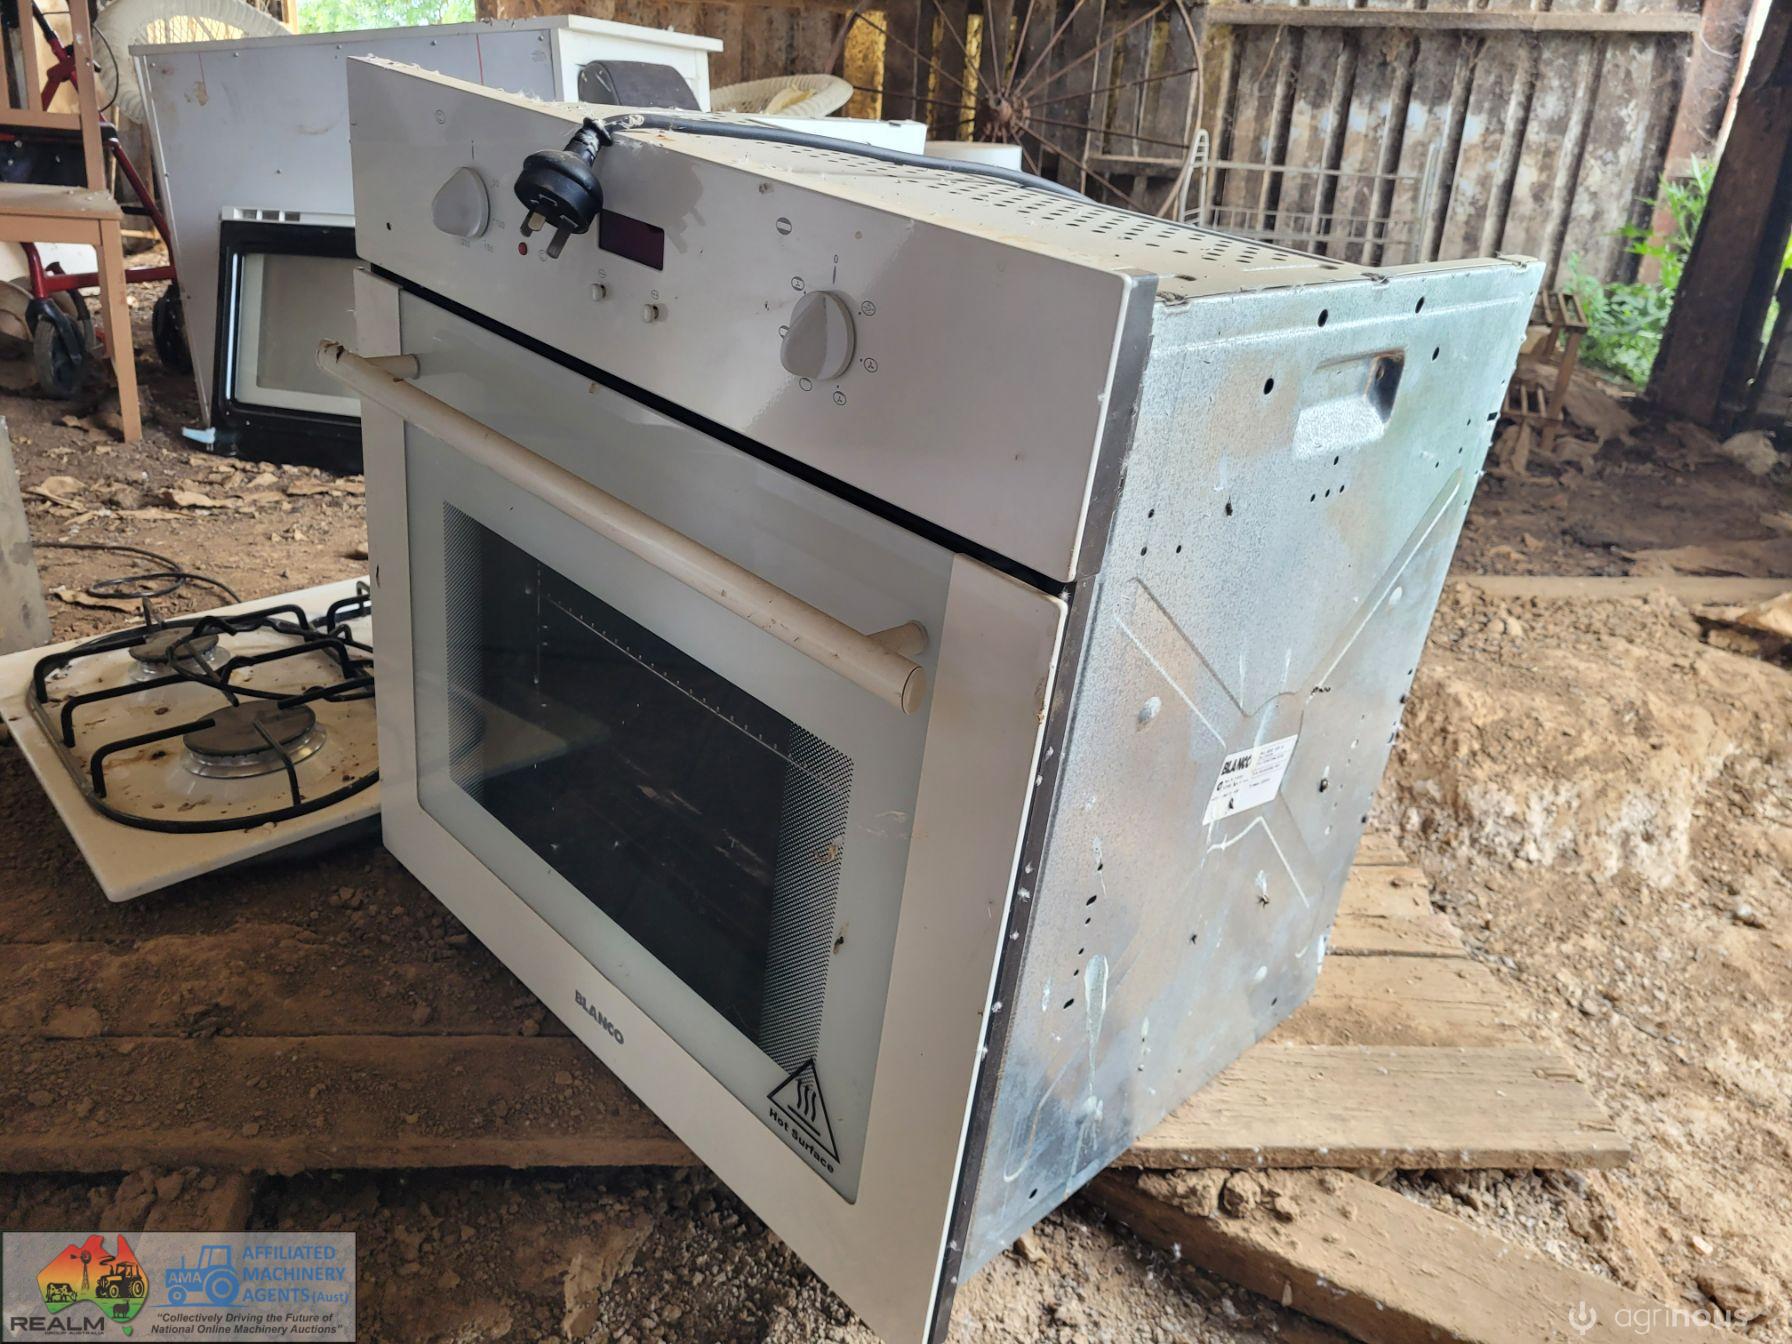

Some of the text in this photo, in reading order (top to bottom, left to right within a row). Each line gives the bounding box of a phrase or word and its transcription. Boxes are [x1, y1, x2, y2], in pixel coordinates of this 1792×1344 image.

[574, 989, 625, 1045] BLANCO
[768, 1107, 835, 1174] Hot Surface
